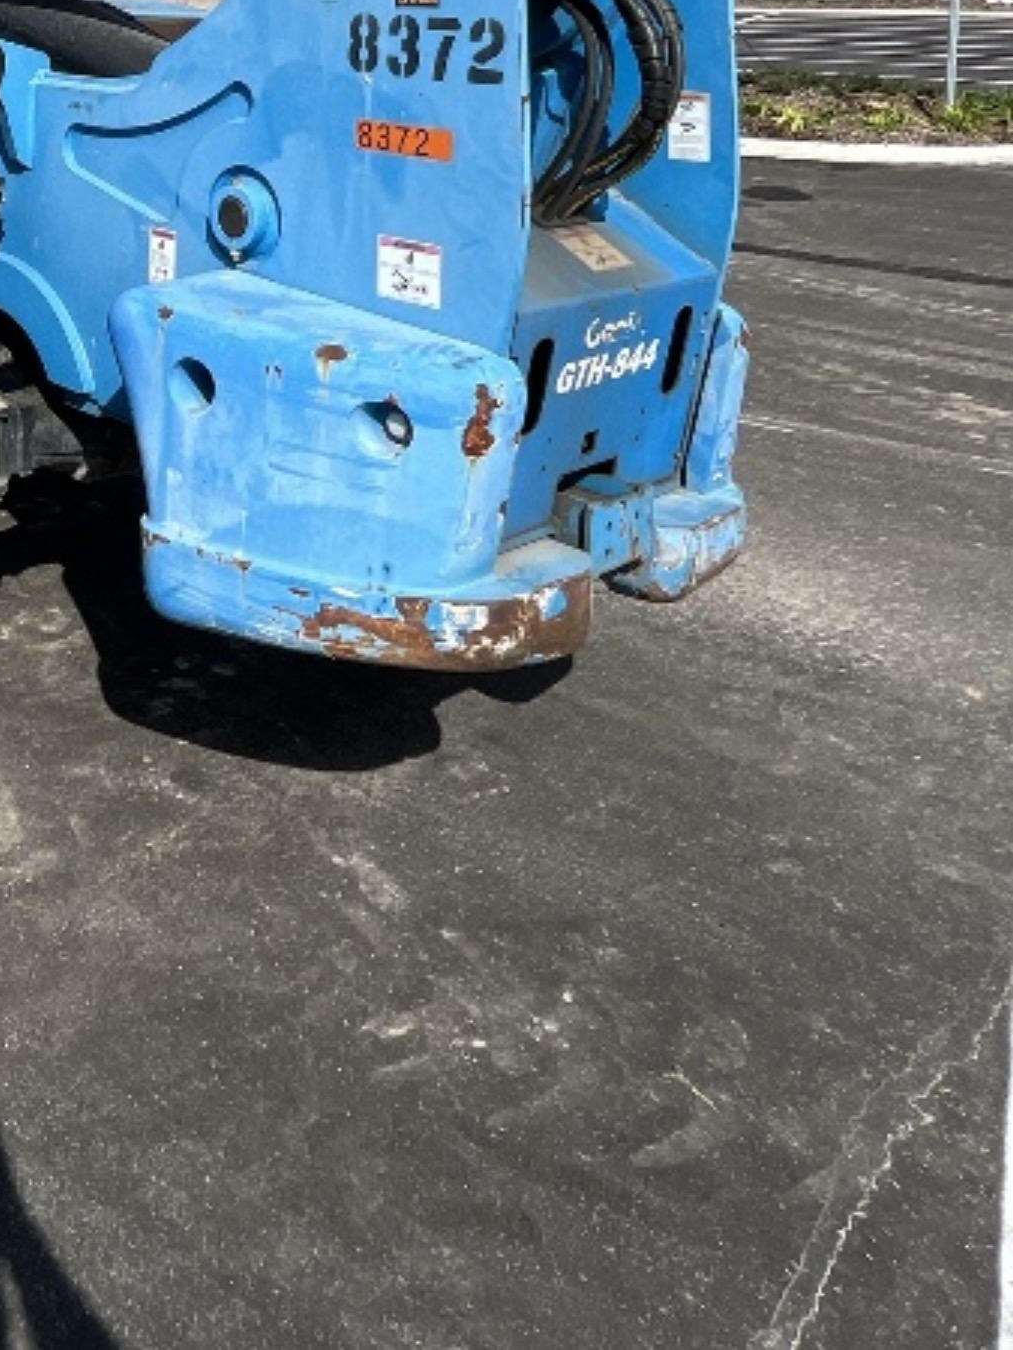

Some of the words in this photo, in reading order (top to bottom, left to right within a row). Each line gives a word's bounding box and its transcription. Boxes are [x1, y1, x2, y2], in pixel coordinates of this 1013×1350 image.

[348, 13, 506, 85] 8372
[357, 121, 430, 157] 8372
[556, 338, 660, 394] GTH-844
